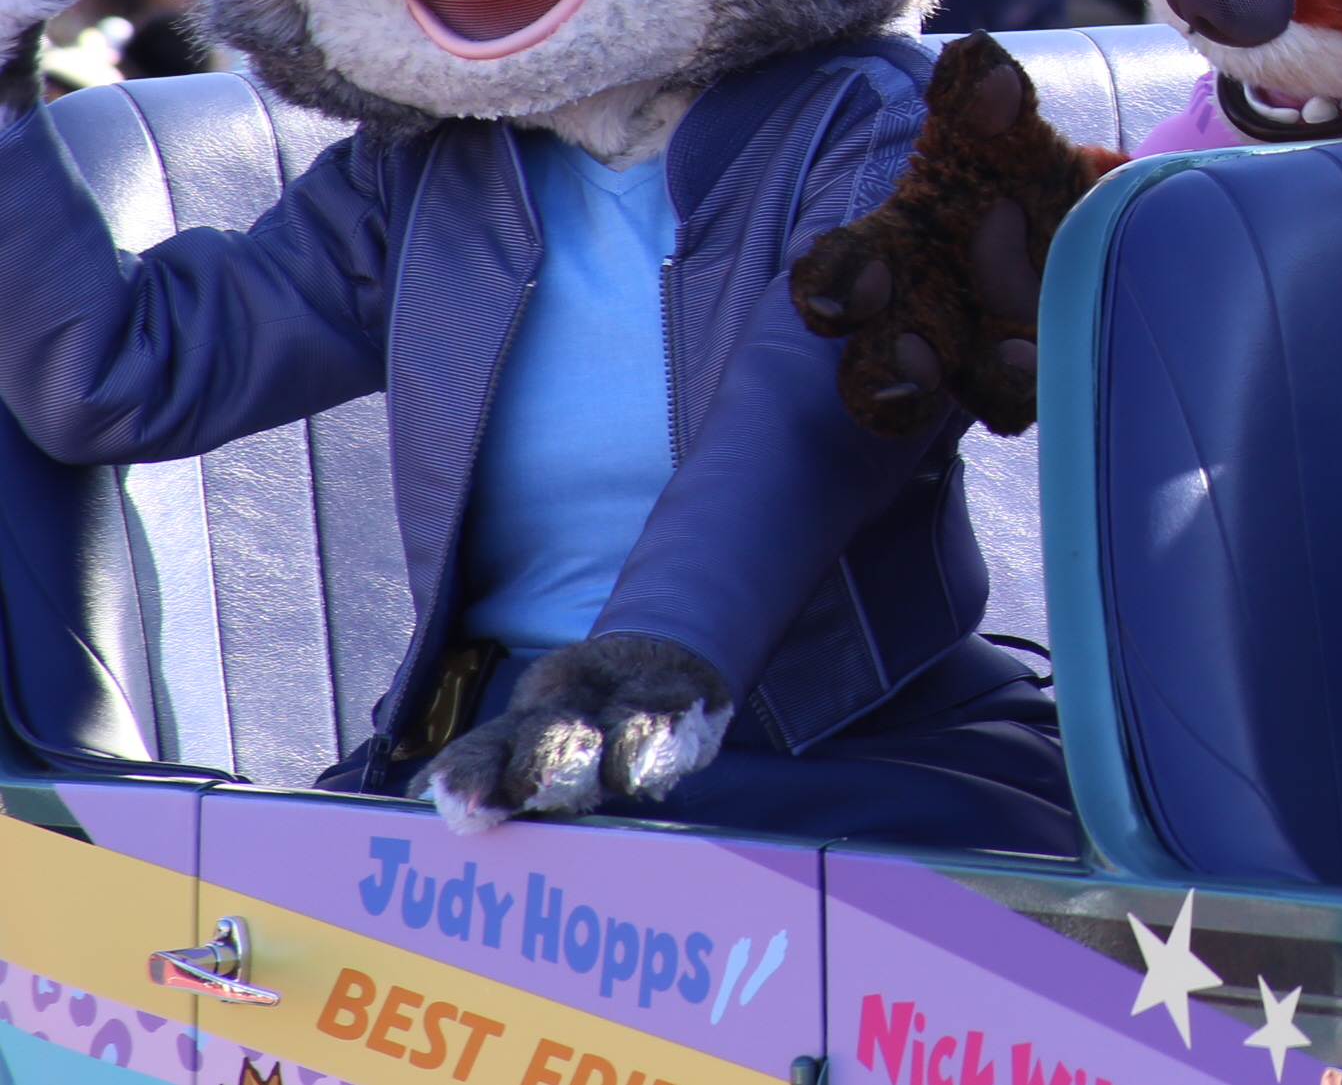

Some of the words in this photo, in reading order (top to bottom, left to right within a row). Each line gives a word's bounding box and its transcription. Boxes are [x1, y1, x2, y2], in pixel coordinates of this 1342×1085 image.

[521, 872, 714, 1009] Hopps
[316, 967, 506, 1083] BEST
[856, 993, 995, 1085] Nick
